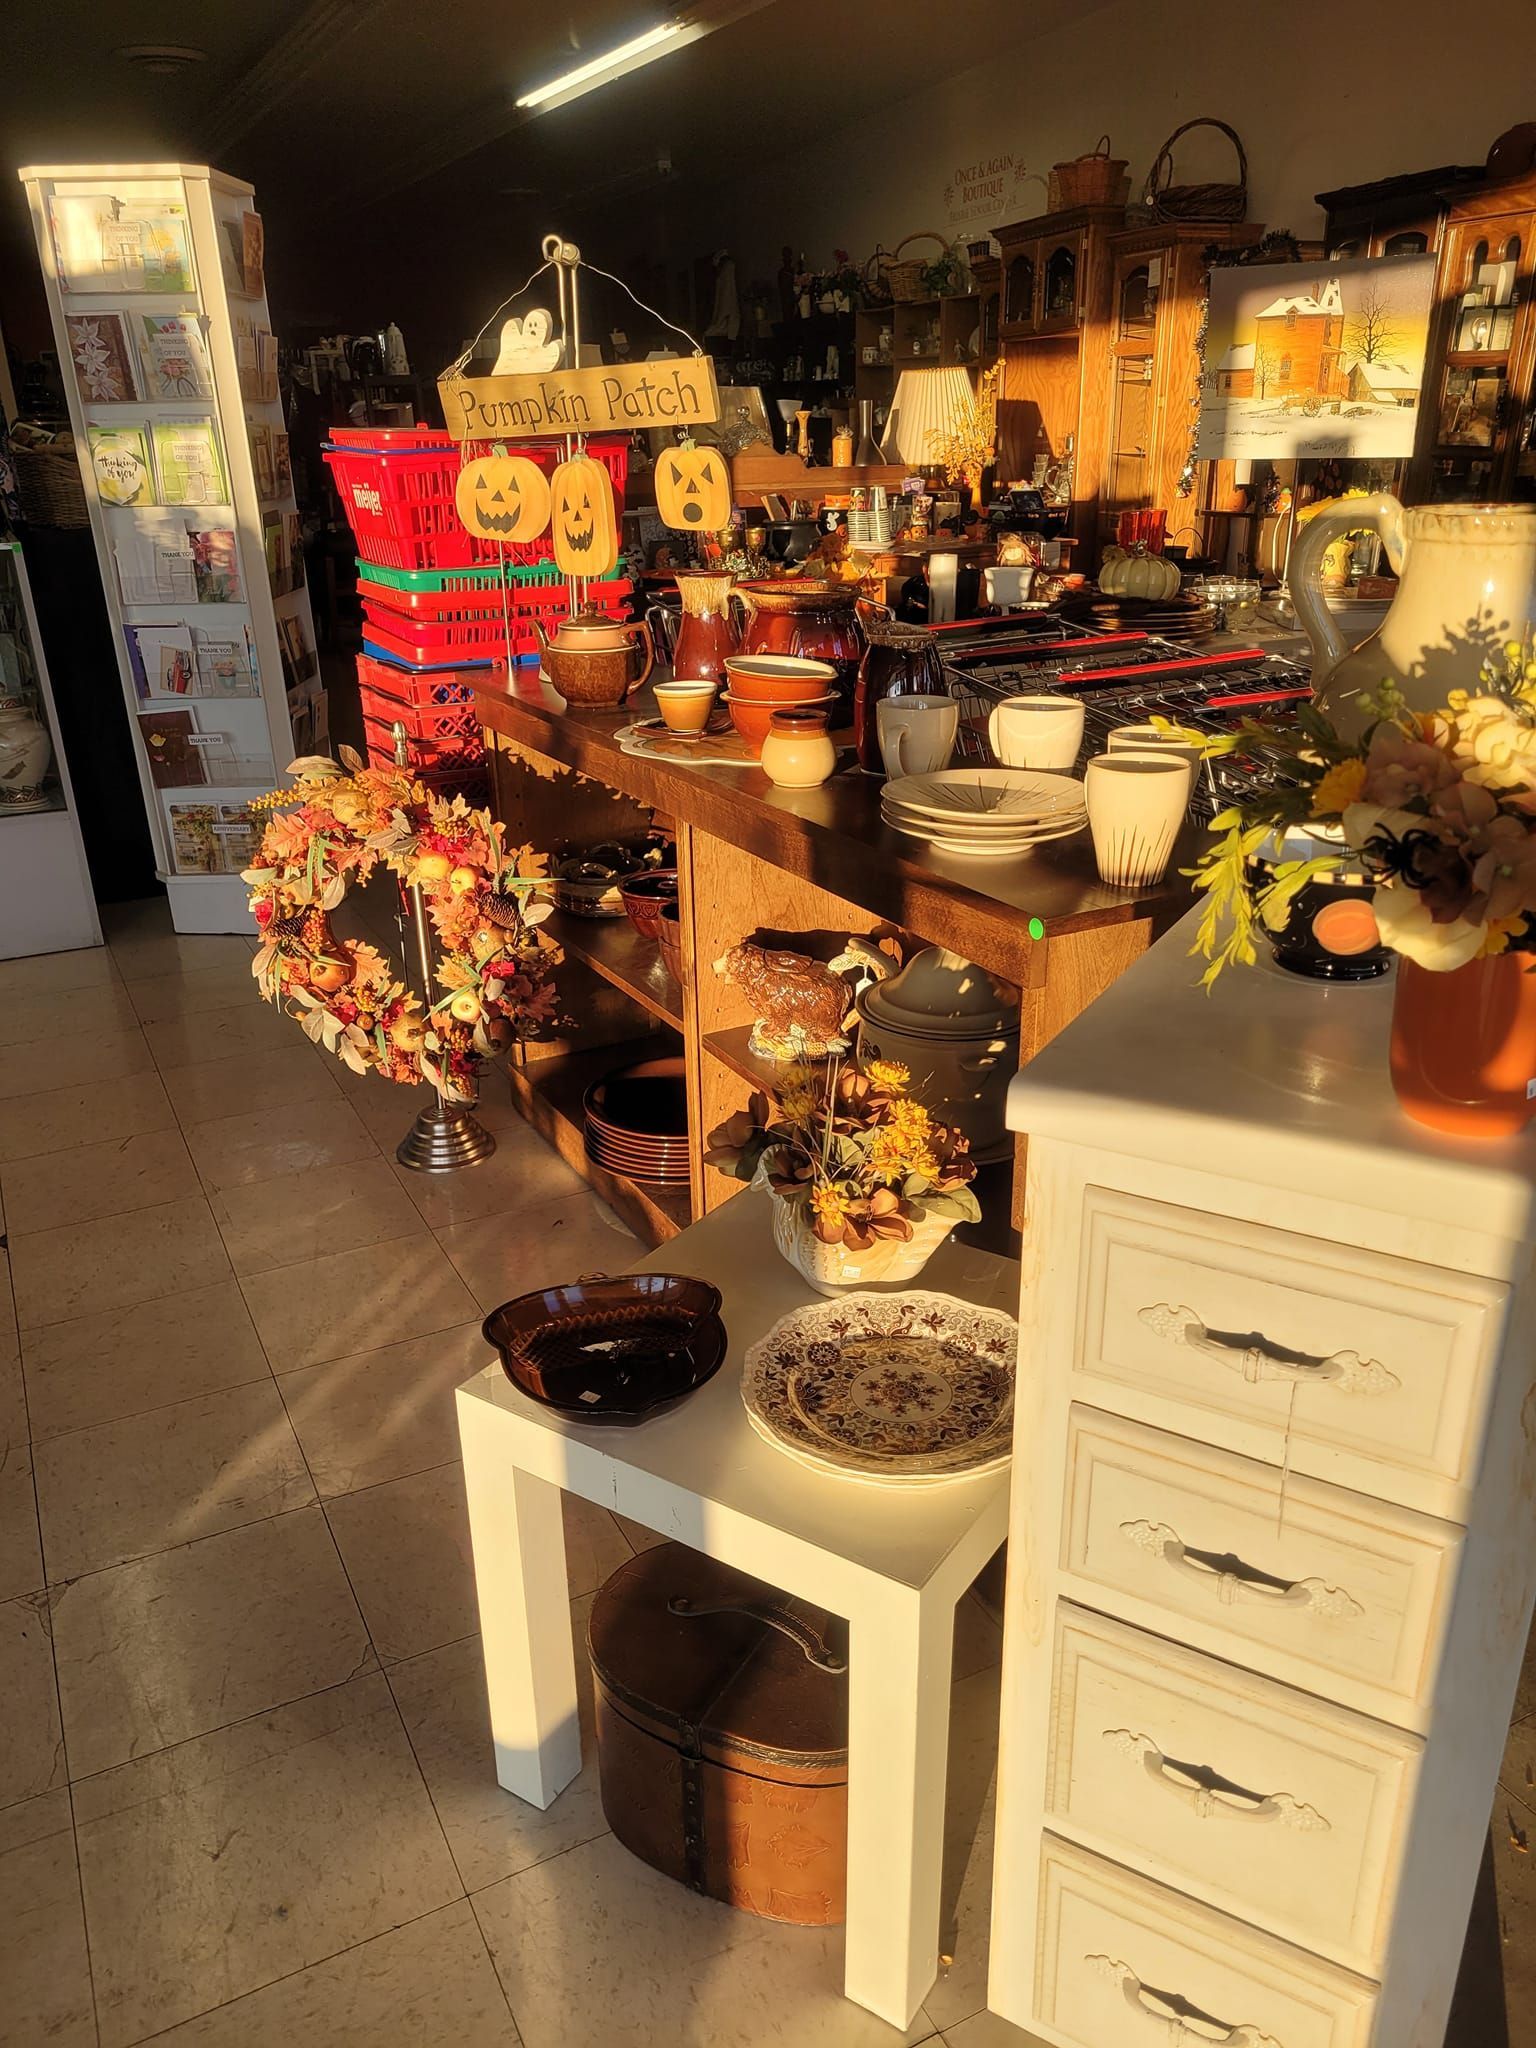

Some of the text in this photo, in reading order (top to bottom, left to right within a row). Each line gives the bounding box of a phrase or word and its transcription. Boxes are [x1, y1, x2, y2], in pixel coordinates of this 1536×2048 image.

[954, 152, 1014, 186] ONCE & AGAIN
[962, 177, 1004, 203] BOUTIQUE
[457, 370, 700, 432] Pumpkin Patch
[98, 455, 138, 472] thinking
[116, 468, 135, 483] you
